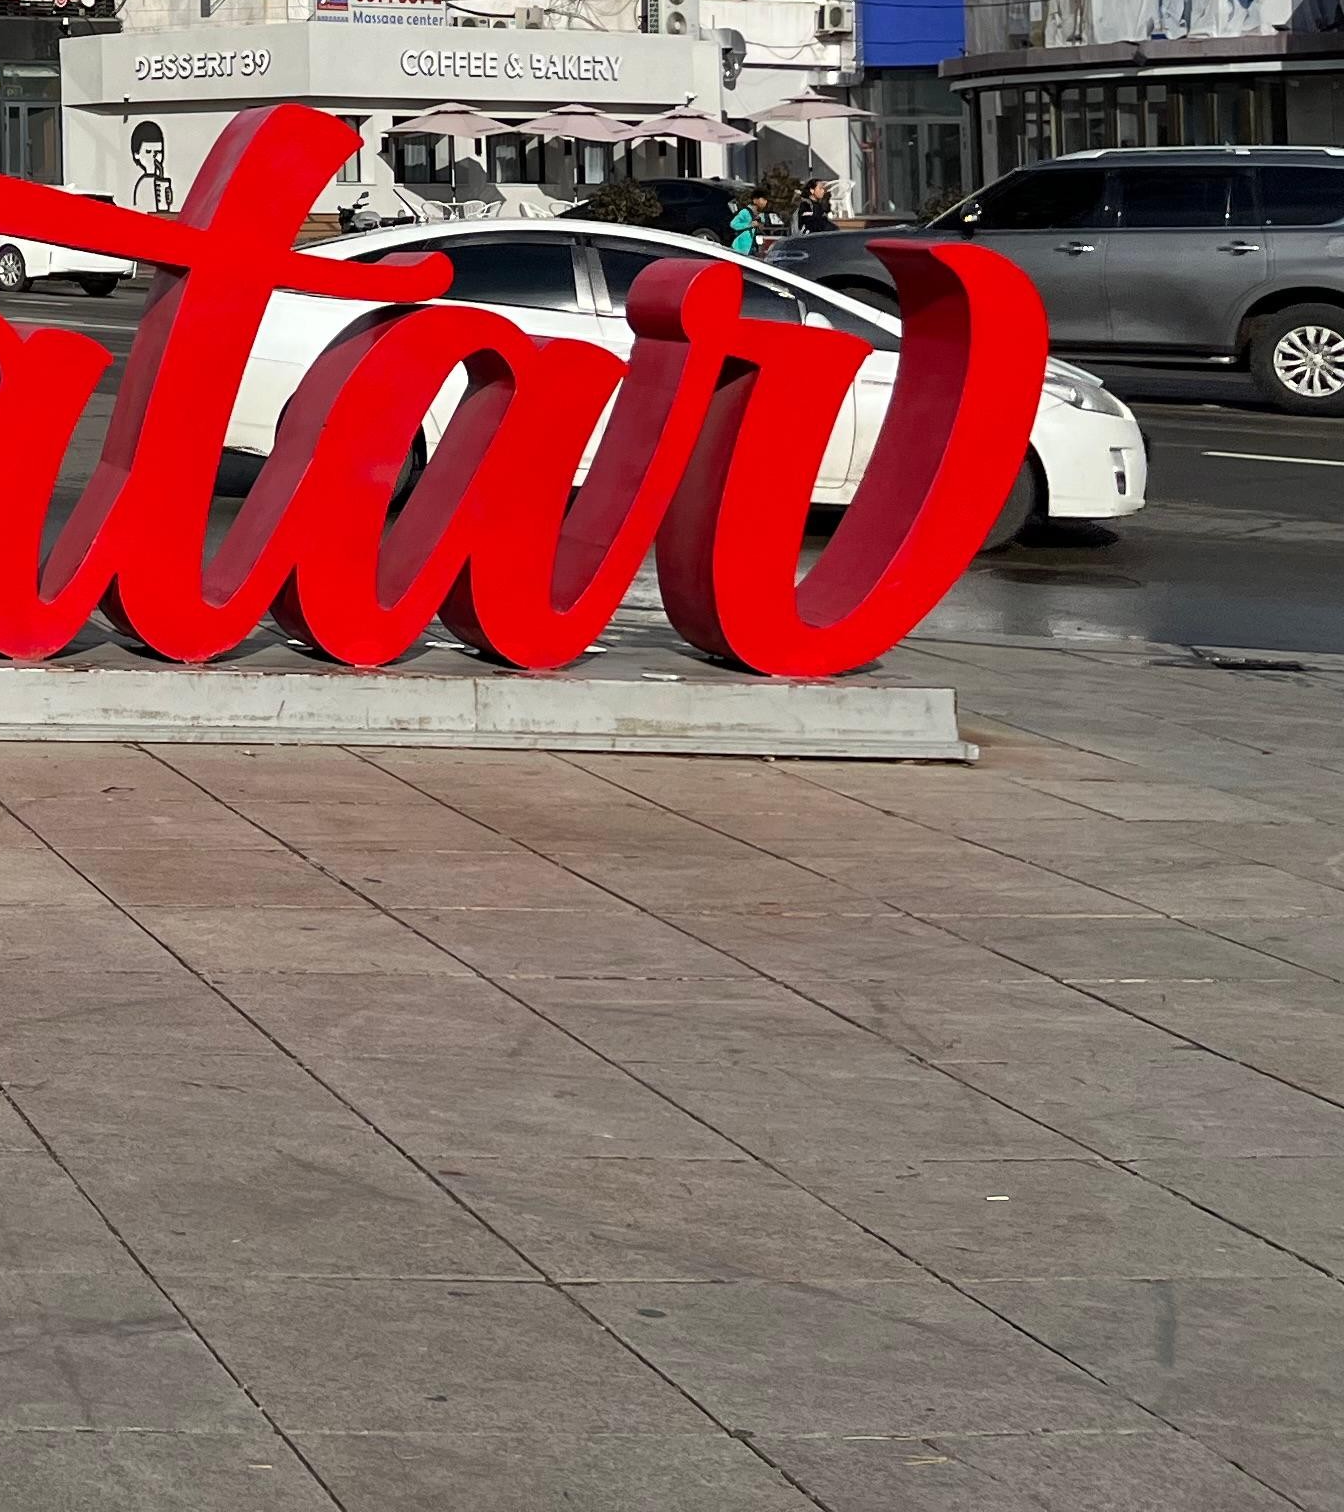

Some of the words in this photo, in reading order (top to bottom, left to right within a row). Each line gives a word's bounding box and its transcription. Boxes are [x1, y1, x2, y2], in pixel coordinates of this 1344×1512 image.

[406, 14, 444, 26] center
[135, 51, 237, 80] DESSERT
[240, 48, 272, 76] 39
[400, 49, 498, 77] COFFEE
[504, 52, 523, 78] &
[529, 53, 623, 81] BAKERY
